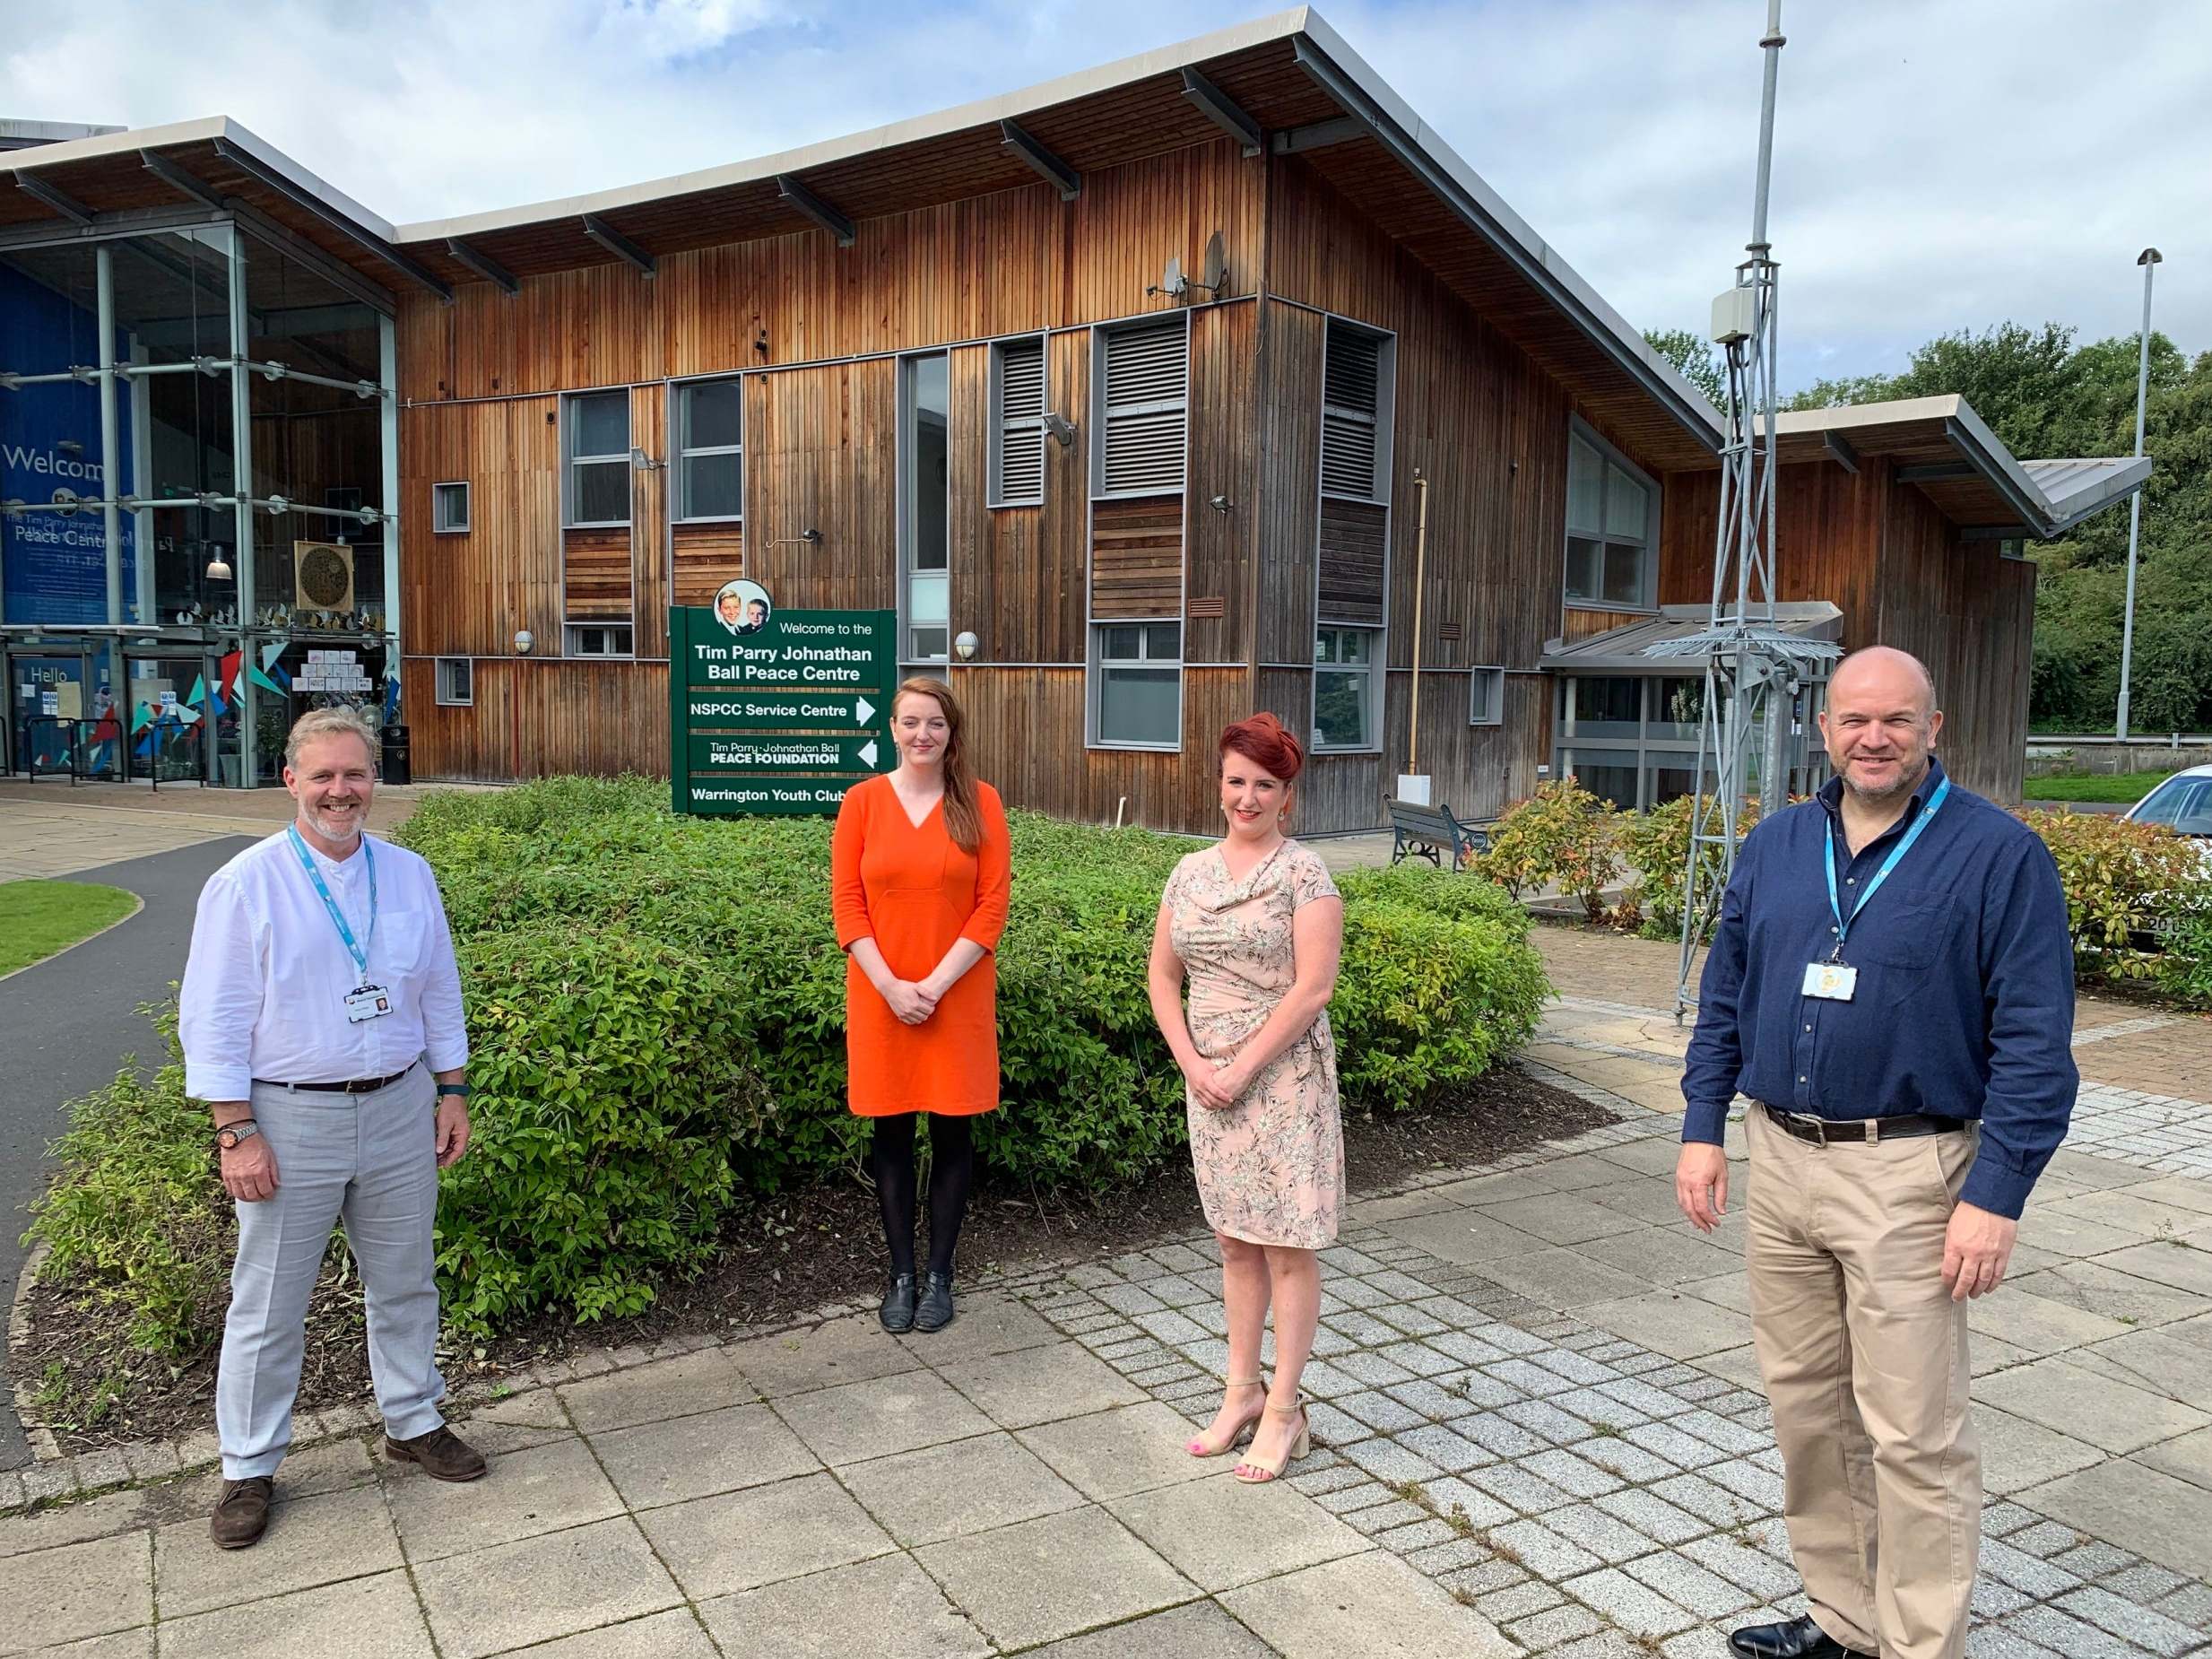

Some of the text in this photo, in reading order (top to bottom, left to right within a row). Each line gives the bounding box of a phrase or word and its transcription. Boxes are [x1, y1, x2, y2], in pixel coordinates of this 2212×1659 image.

[2, 444, 104, 482] Welcom
[15, 525, 58, 544] Peace
[64, 530, 105, 548] Centr
[779, 622, 872, 635] Welcome to the
[694, 645, 872, 664] Tim Parry Johnathan
[31, 666, 67, 683] Hello
[707, 664, 861, 682] Ball Peace Centre
[690, 703, 847, 717] NSPCC Service Centre
[710, 742, 728, 752] Tim
[820, 743, 840, 753] Ball
[710, 753, 839, 765] PEACE FOUNDATION
[691, 788, 768, 803] Warrington
[771, 789, 811, 802] Youth
